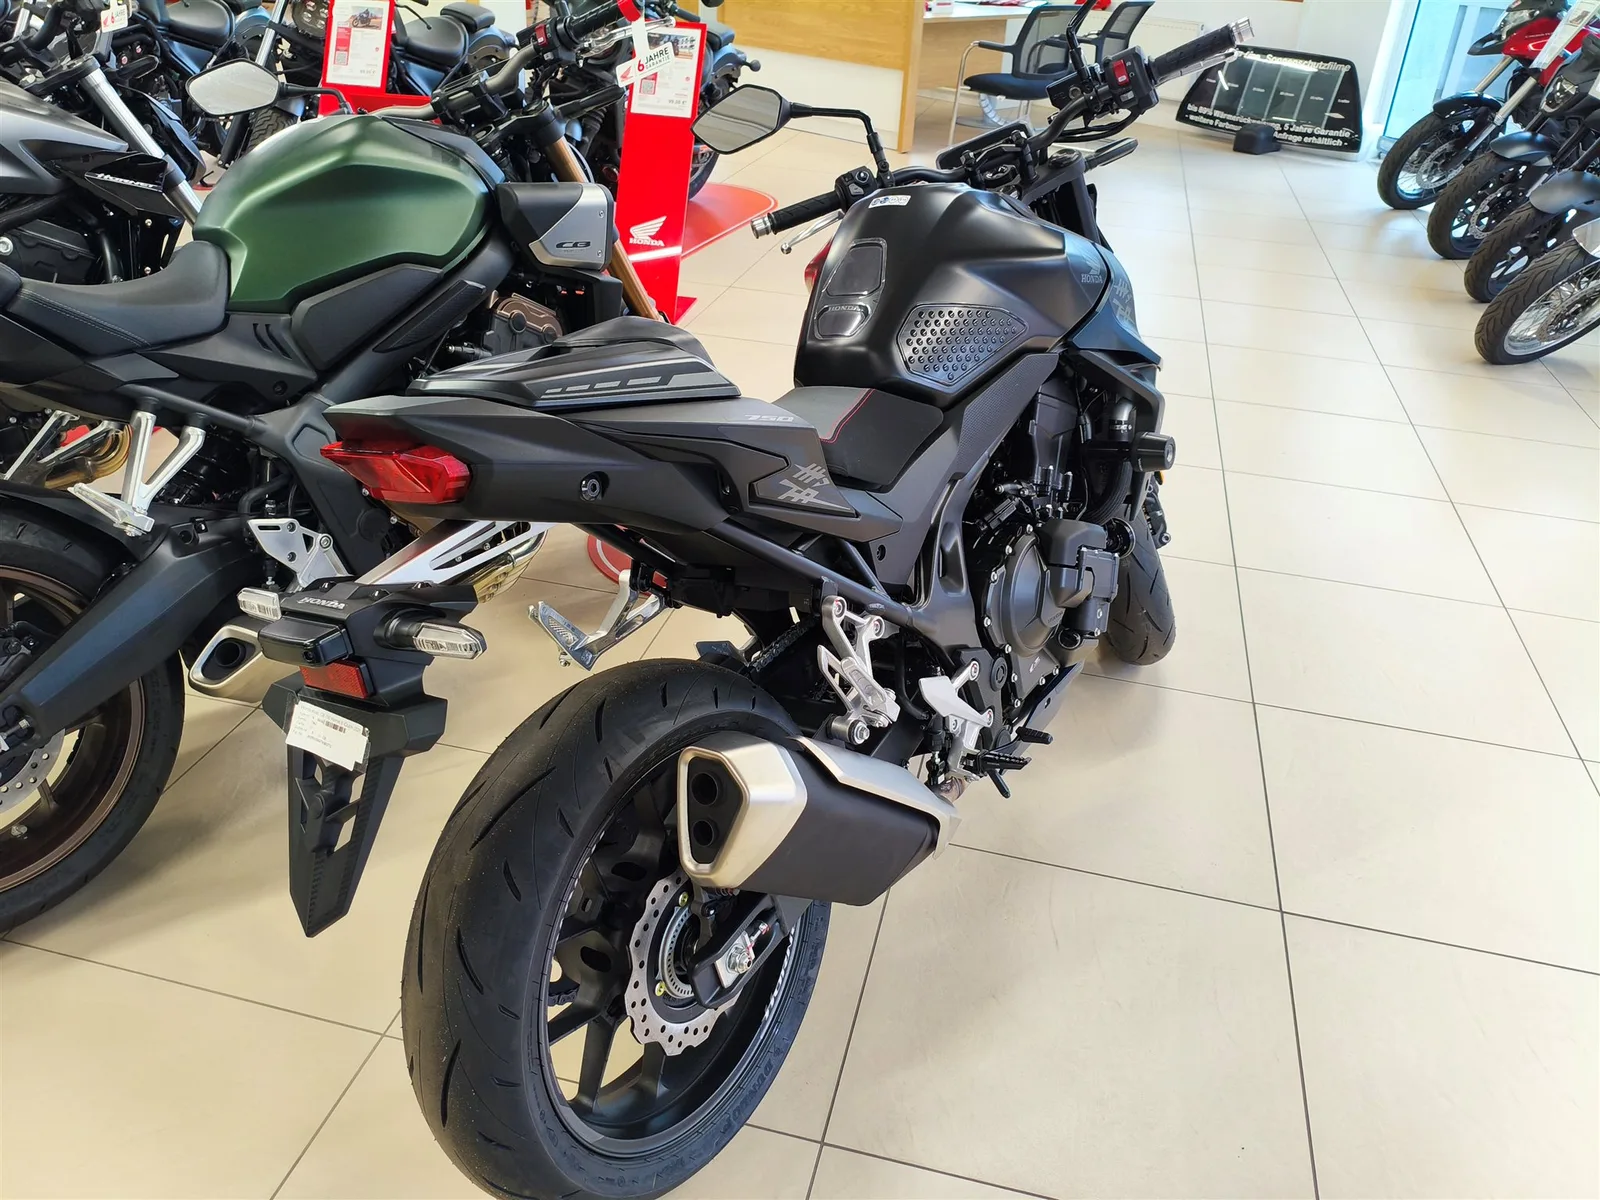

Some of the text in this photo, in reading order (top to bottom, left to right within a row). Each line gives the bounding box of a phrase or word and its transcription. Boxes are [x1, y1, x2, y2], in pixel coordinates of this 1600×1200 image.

[637, 46, 669, 72] 6 JAHRE
[1290, 124, 1313, 134] Jahre
[1314, 127, 1351, 138] Garantie
[1273, 131, 1303, 143] Anfrage
[1303, 136, 1343, 147] erhältlich
[555, 241, 592, 249] CB
[629, 237, 665, 247] HONDA
[1081, 273, 1104, 284] HONDA
[744, 414, 795, 423] 750
[297, 596, 346, 610] HONDA
